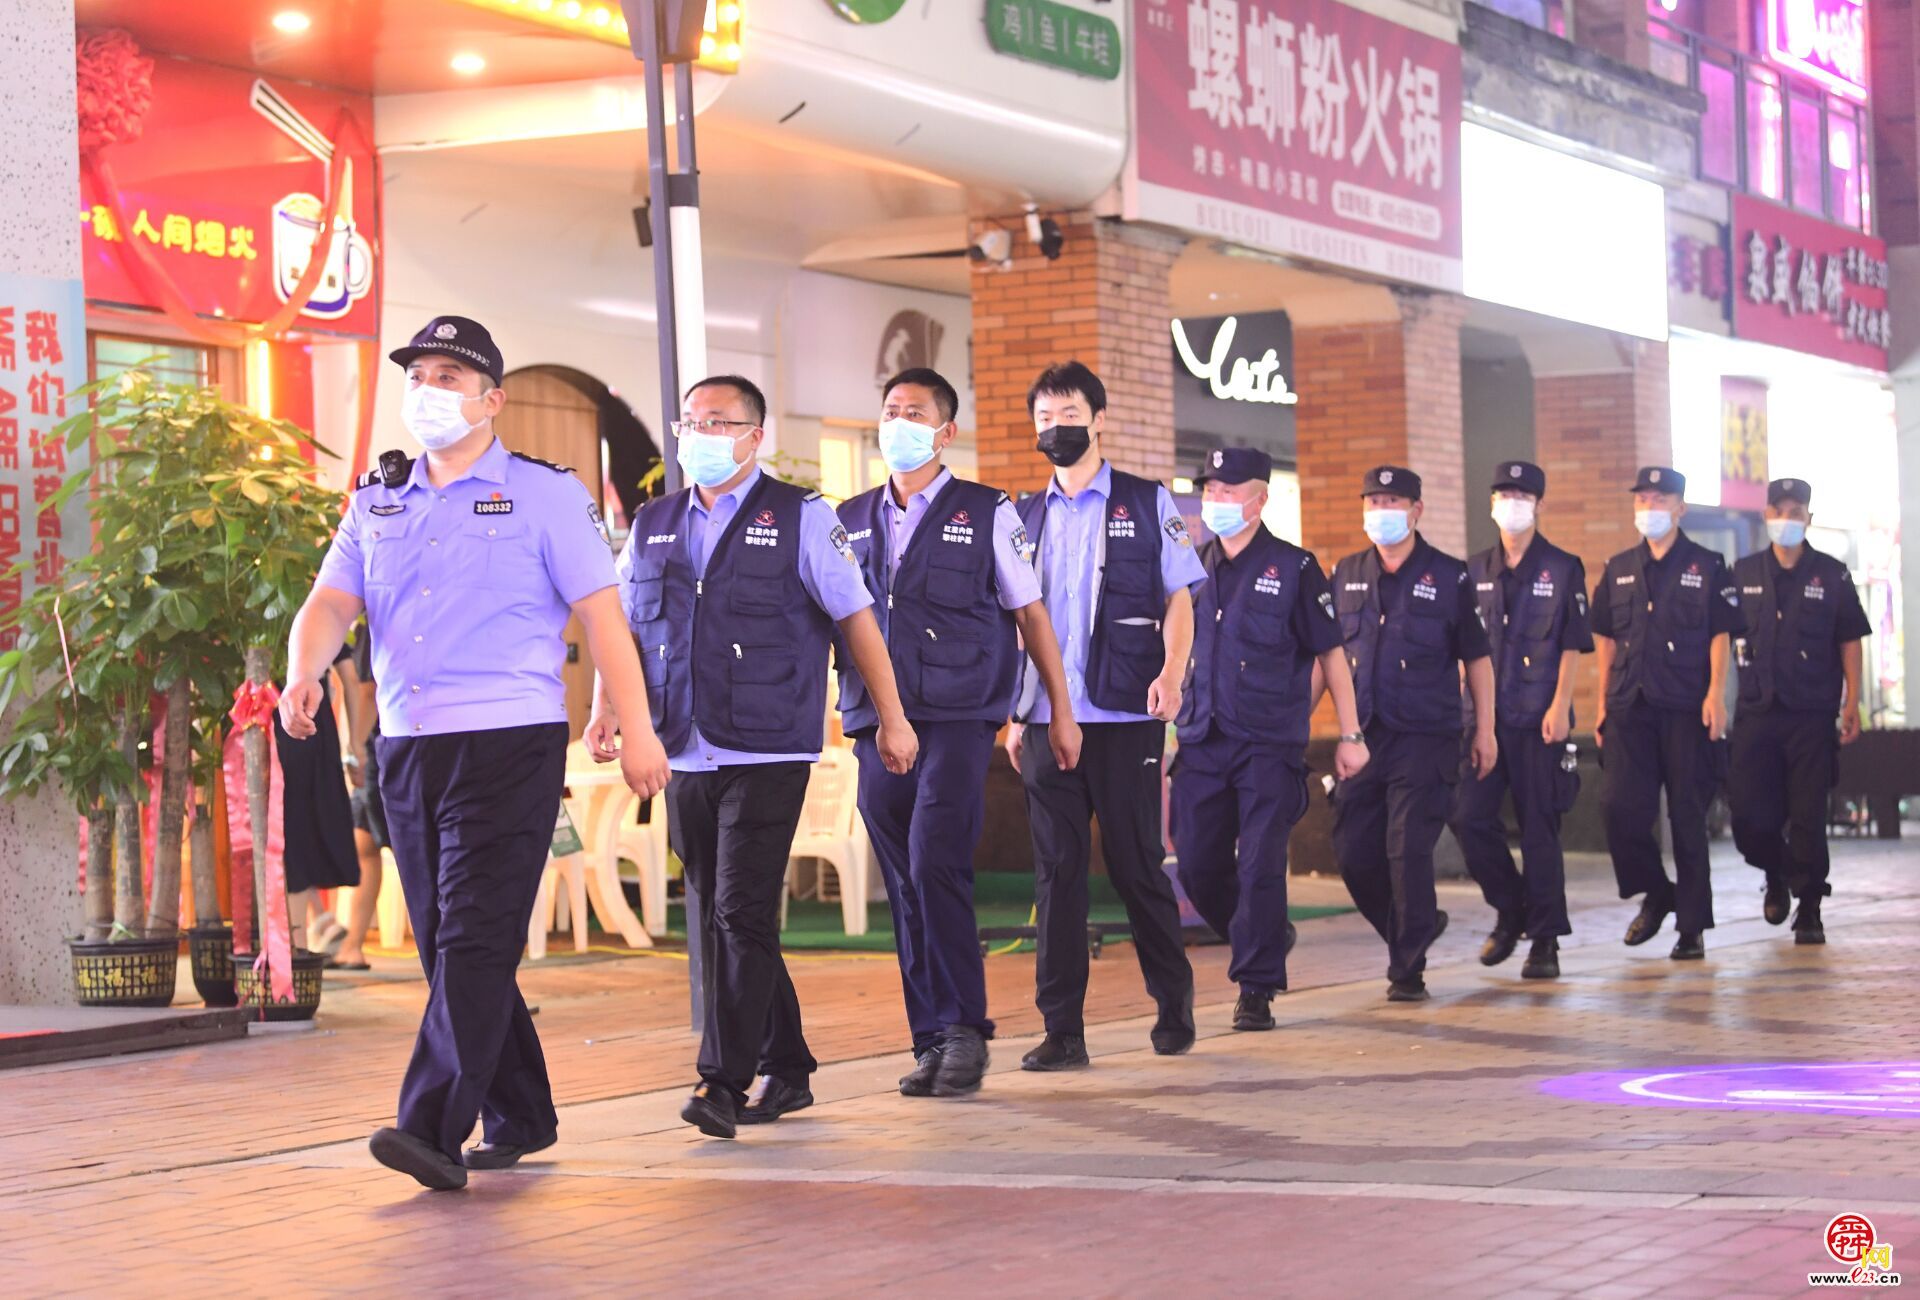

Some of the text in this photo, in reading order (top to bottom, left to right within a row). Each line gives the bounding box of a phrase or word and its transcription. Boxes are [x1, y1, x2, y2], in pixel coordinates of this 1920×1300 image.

[1187, 0, 1443, 191] 螺蛳粉火锅
[476, 503, 512, 513] 108332
